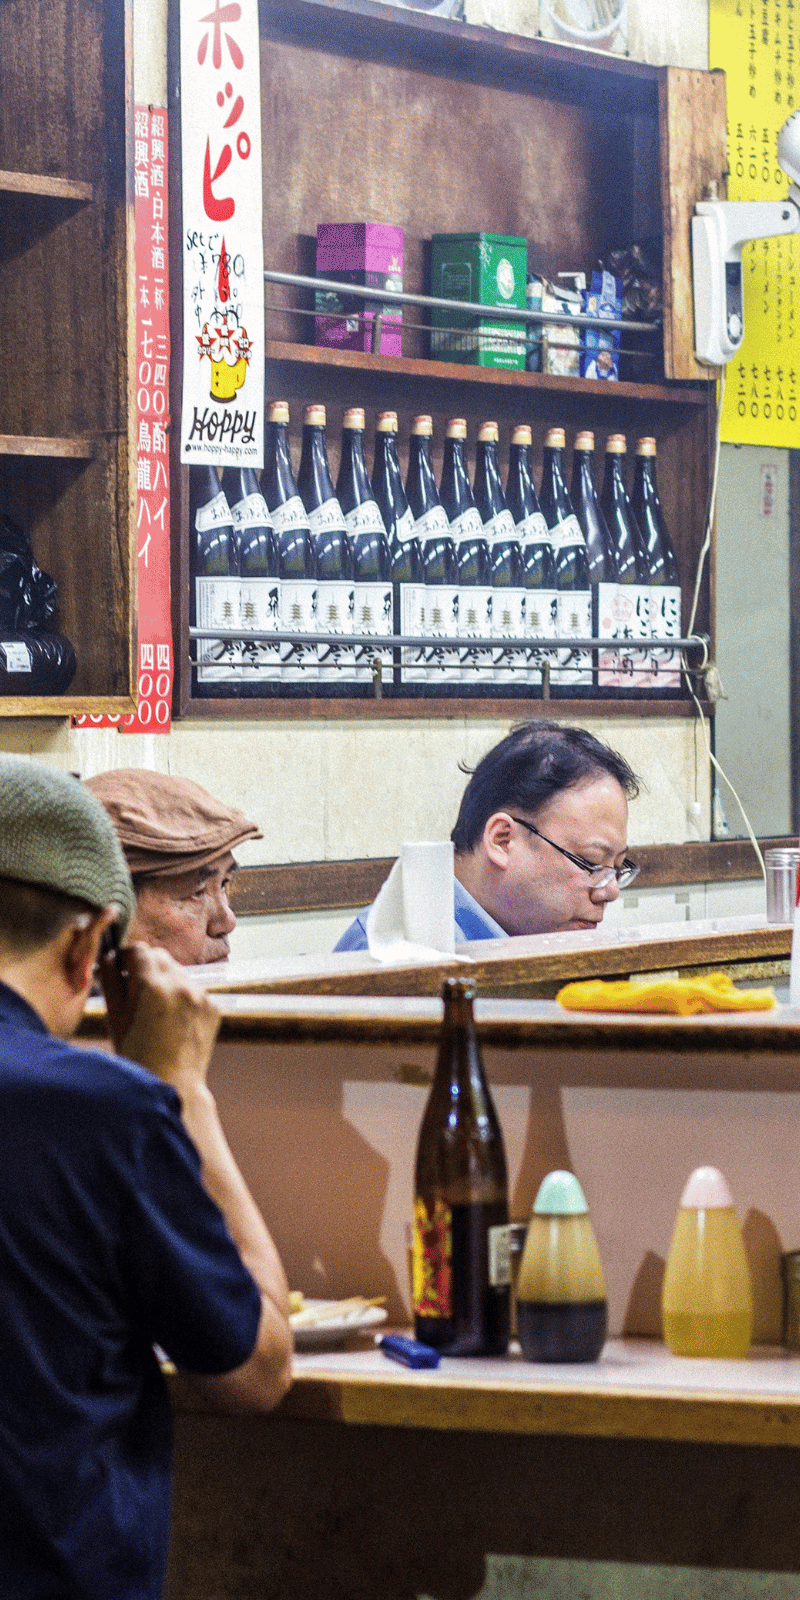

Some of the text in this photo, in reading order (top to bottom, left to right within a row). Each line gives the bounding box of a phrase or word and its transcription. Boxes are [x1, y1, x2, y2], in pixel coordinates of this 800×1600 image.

[134, 111, 149, 198] 紹興酒
[137, 643, 154, 725] 四〇〇
[155, 643, 170, 725] 四〇〇
